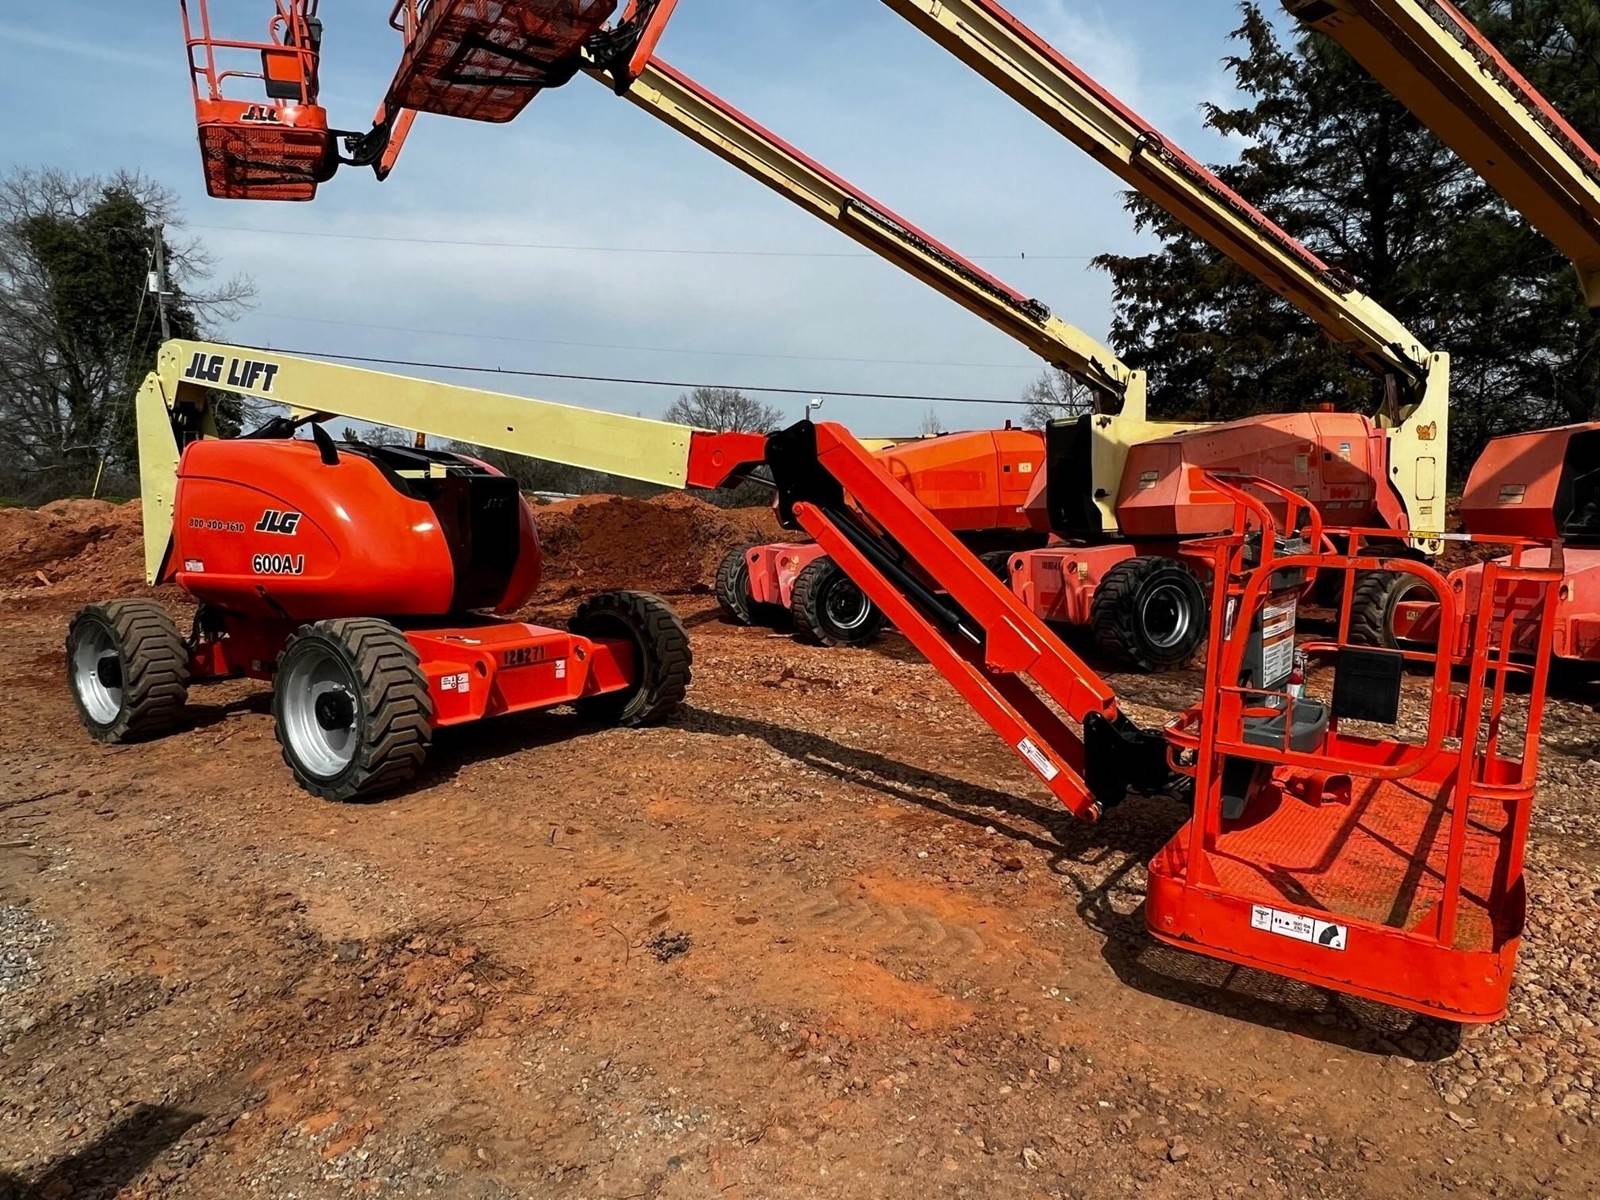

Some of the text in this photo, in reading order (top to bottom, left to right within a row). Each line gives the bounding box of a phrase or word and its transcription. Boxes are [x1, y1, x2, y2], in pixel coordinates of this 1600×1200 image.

[185, 352, 279, 392] JLG LIFT
[255, 509, 301, 535] JLG
[252, 554, 304, 575] 600AJ
